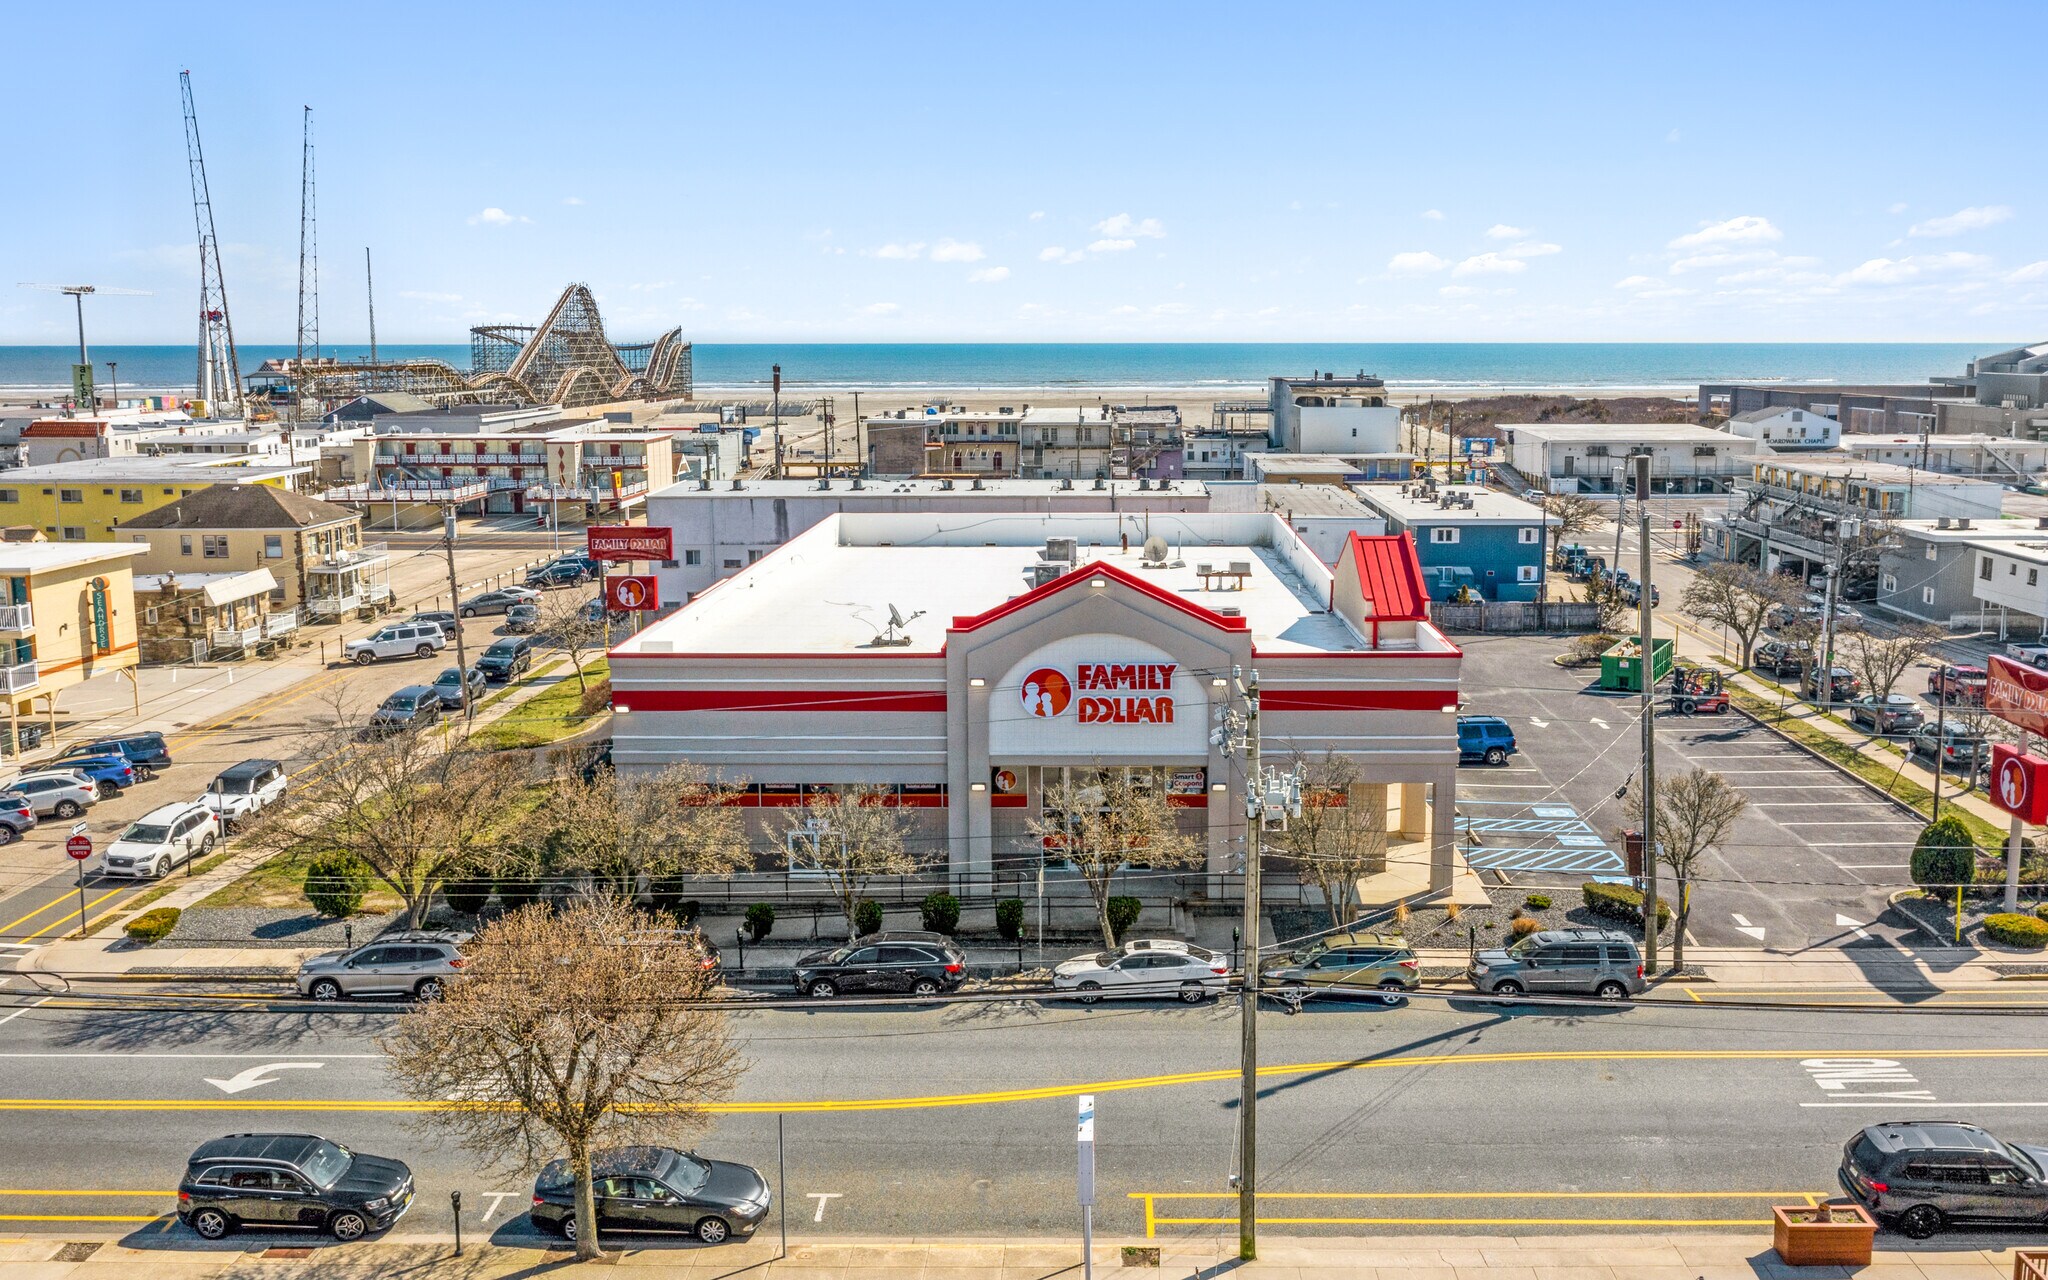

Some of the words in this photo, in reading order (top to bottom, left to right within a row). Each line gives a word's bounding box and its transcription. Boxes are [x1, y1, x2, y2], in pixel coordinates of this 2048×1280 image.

[591, 538, 629, 550] FAMILY
[630, 538, 667, 550] DOLLAR
[96, 592, 106, 648] SEAHORSE
[1077, 663, 1178, 690] FAMILY
[1990, 676, 2024, 706] FAMILY
[1078, 697, 1174, 723] DOLLAR
[1174, 780, 1203, 788] Coupons
[1800, 1058, 1937, 1100] ONLY
